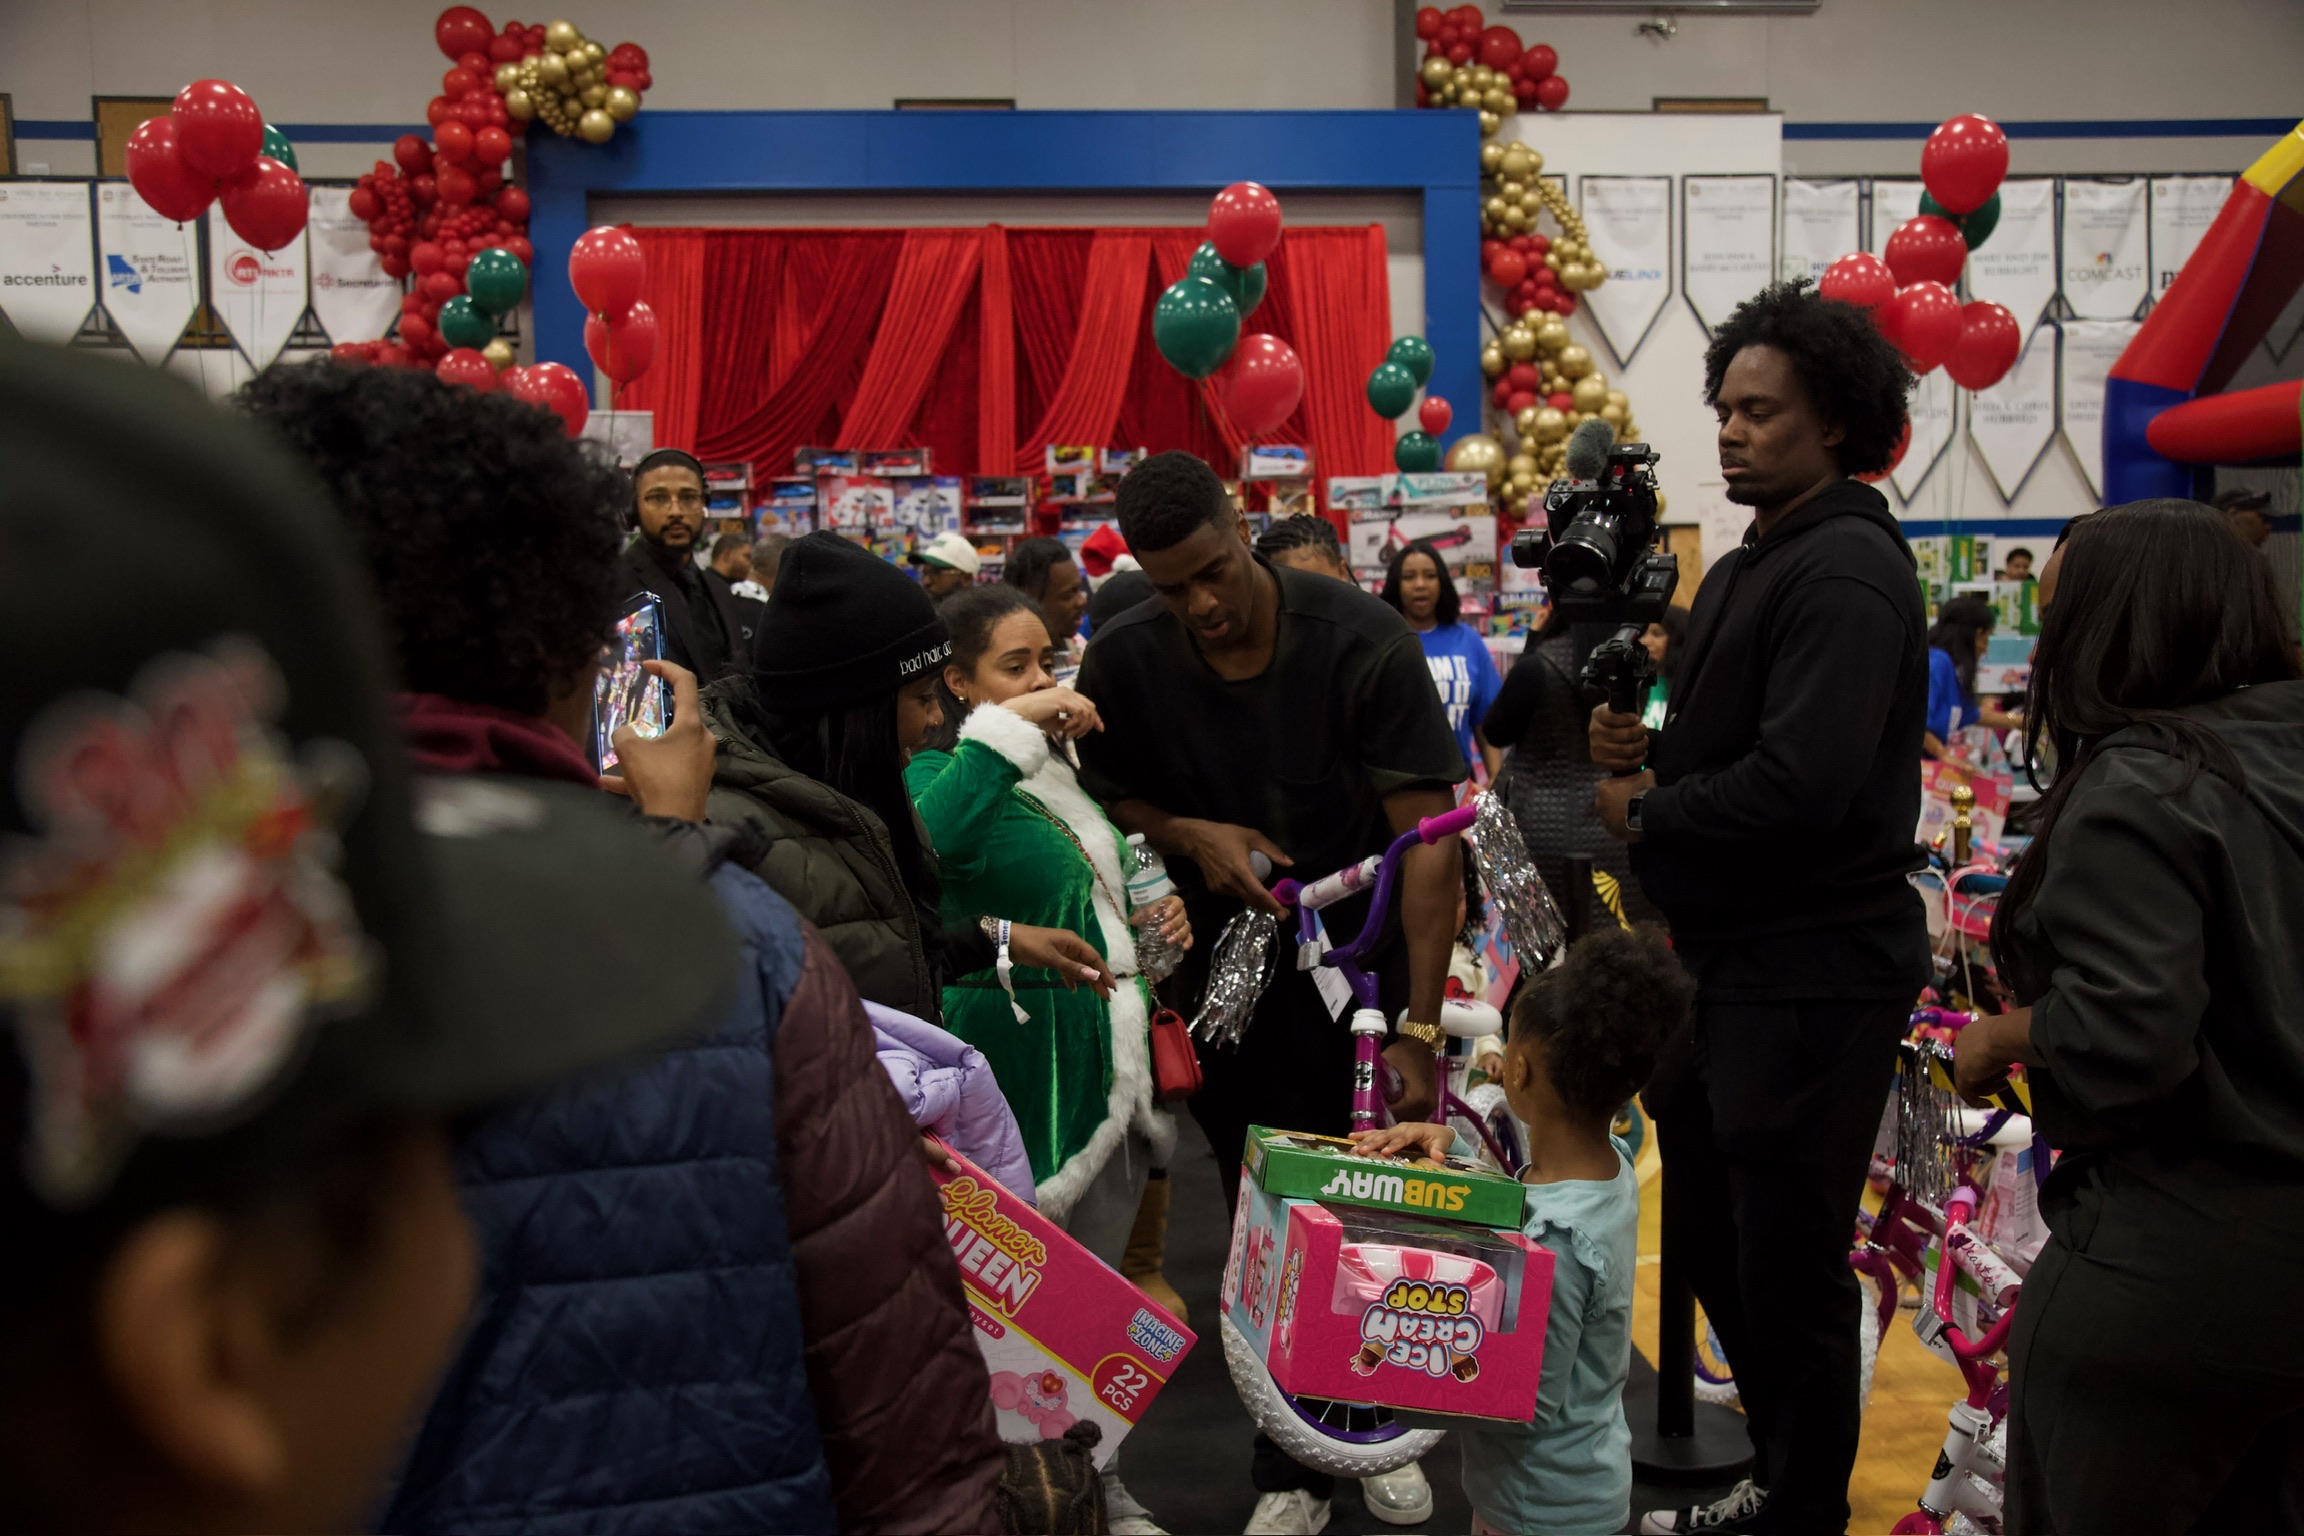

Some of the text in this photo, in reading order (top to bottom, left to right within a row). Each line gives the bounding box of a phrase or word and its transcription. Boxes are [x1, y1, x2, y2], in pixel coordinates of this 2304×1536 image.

[3, 273, 87, 286] accenture
[2067, 267, 2143, 282] COMCAST
[900, 652, 922, 676] bad
[1320, 1169, 1473, 1212] SUBWAY
[941, 1178, 1046, 1265] Glamor
[942, 1214, 1038, 1306] UEEN
[1387, 1283, 1467, 1315] STOP
[968, 1306, 1000, 1335] ayset
[1133, 1309, 1186, 1353] IMAGINE
[1363, 1306, 1480, 1353] CREAM
[1132, 1327, 1165, 1359] ZONE
[1388, 1338, 1448, 1376] ICE
[1112, 1364, 1148, 1397] 22
[1101, 1383, 1133, 1411] PCS
